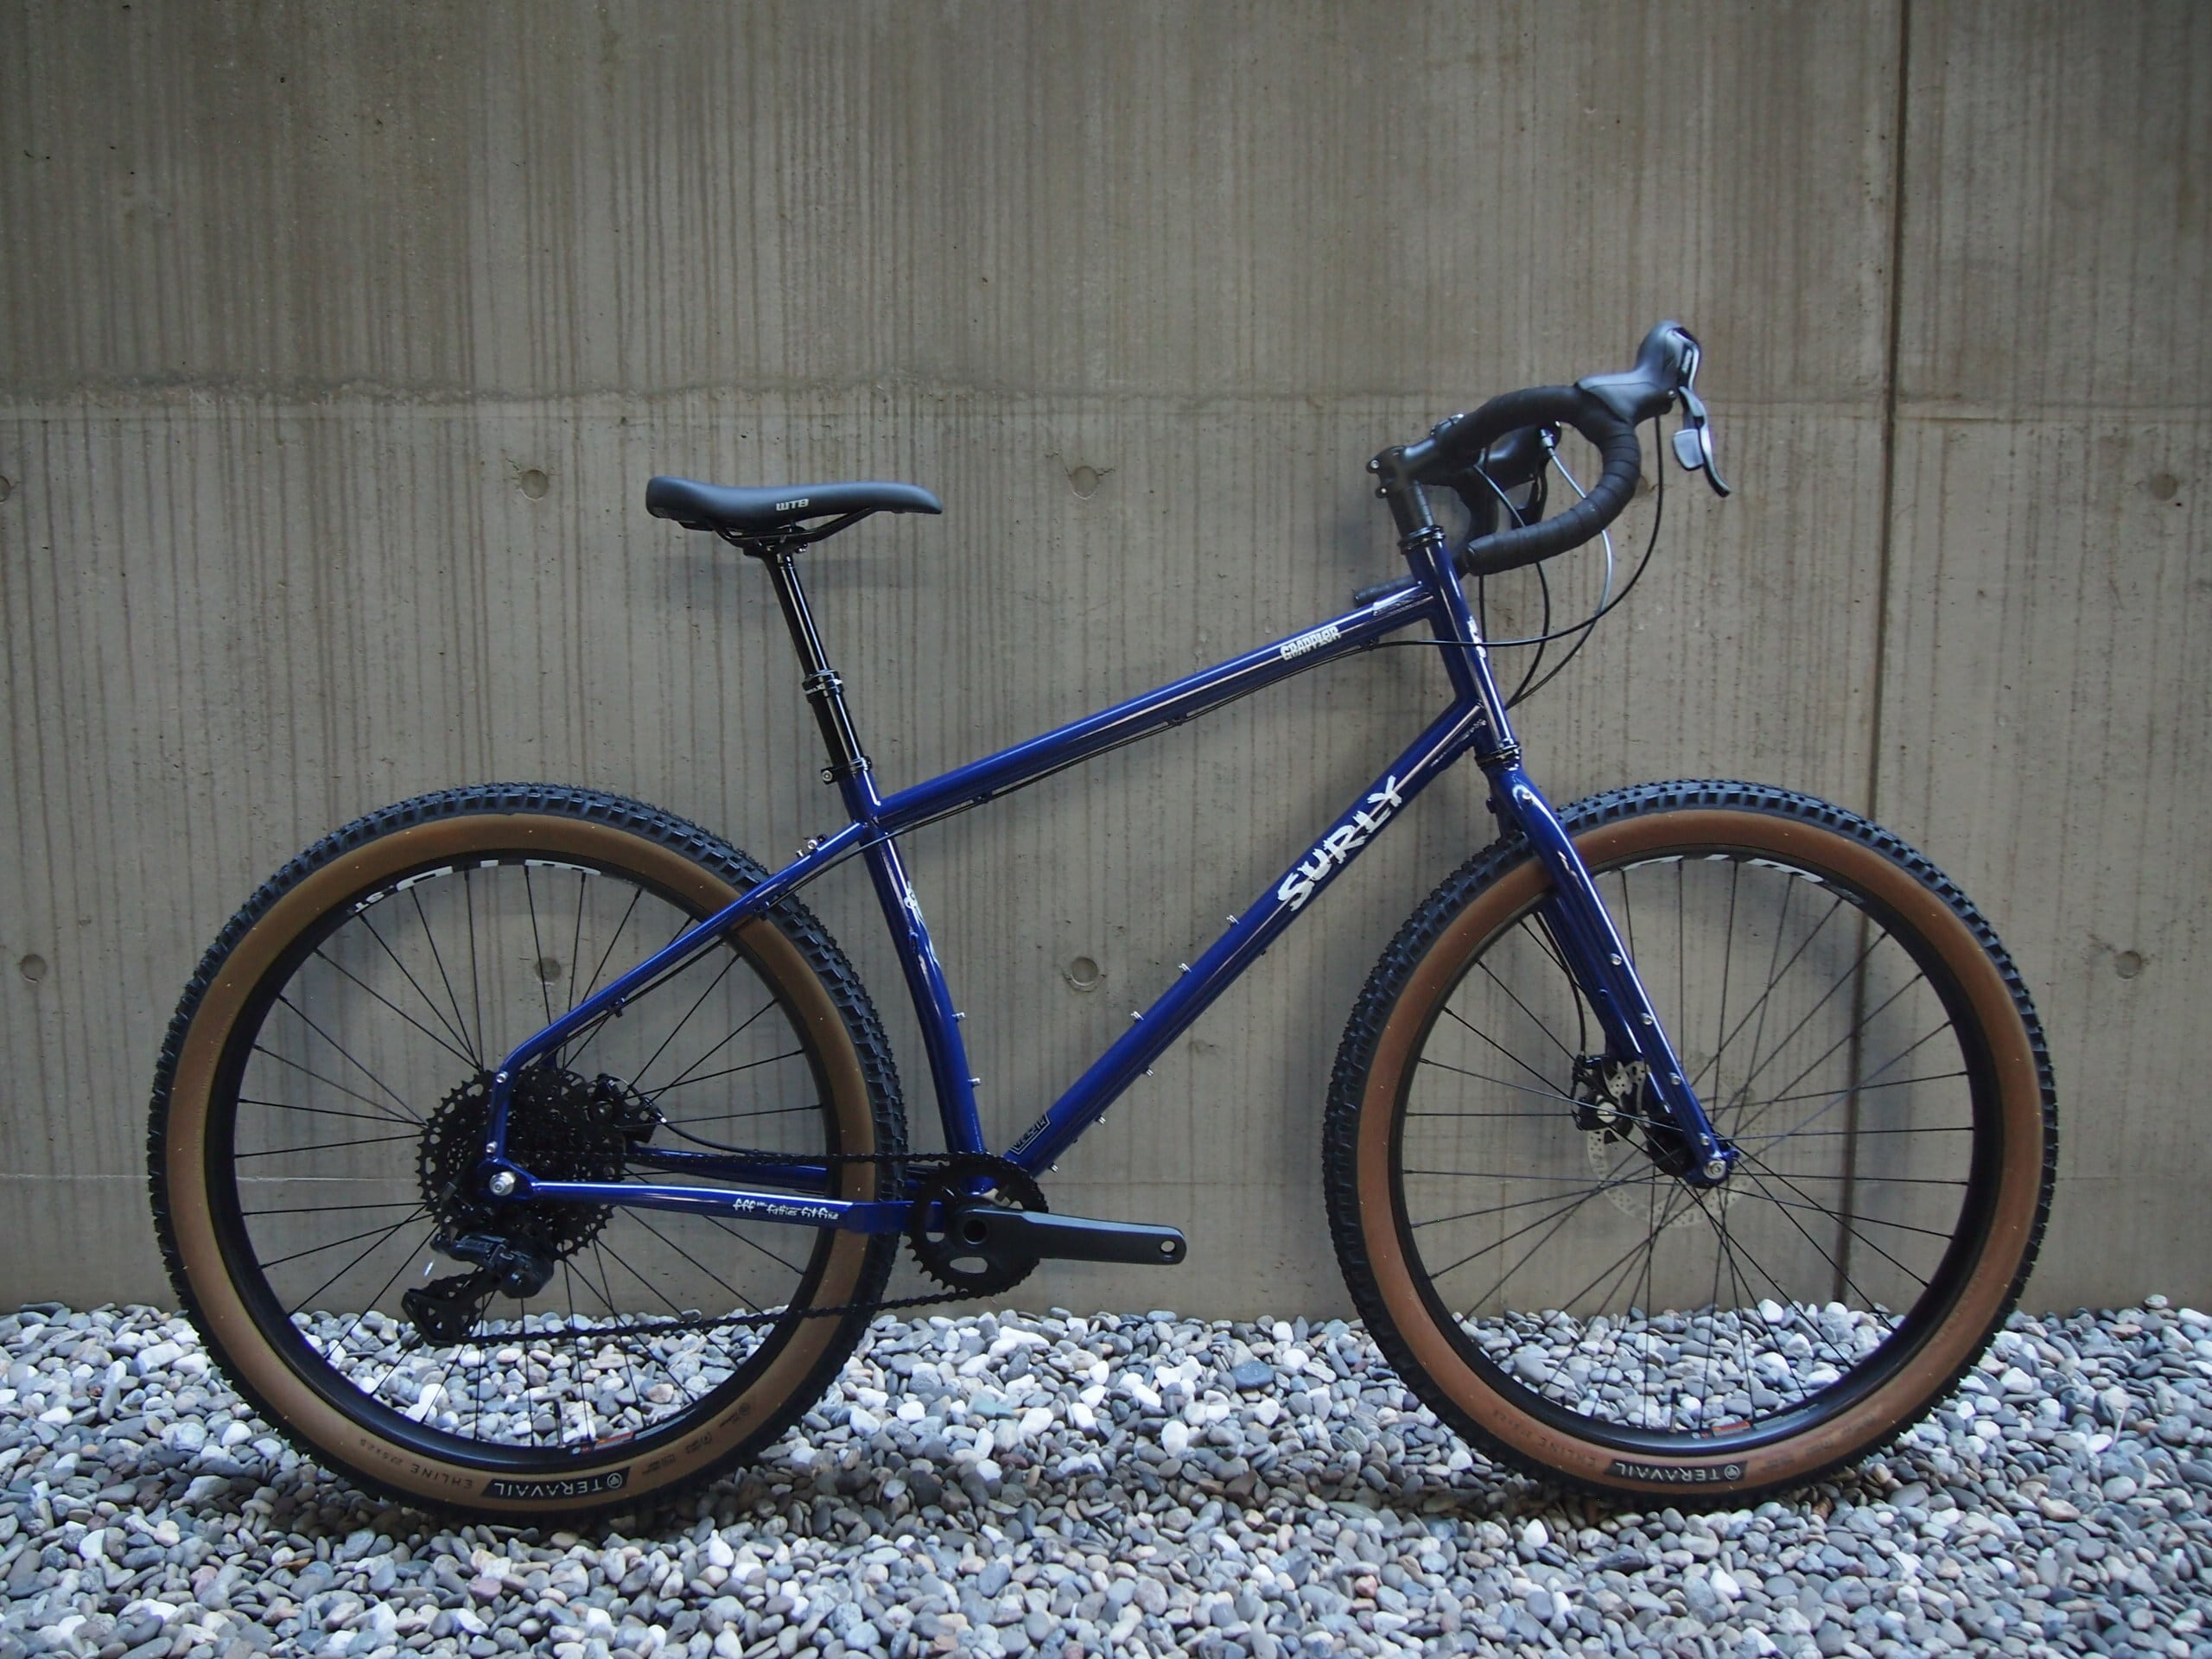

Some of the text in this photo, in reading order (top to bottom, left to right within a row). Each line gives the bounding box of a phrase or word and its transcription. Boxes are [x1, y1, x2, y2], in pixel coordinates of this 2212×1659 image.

[776, 499, 809, 511] WTB
[1278, 775, 1402, 912] SURLY
[1616, 1462, 1720, 1482] TERAVAIL
[494, 1478, 602, 1497] TERAVAIL
